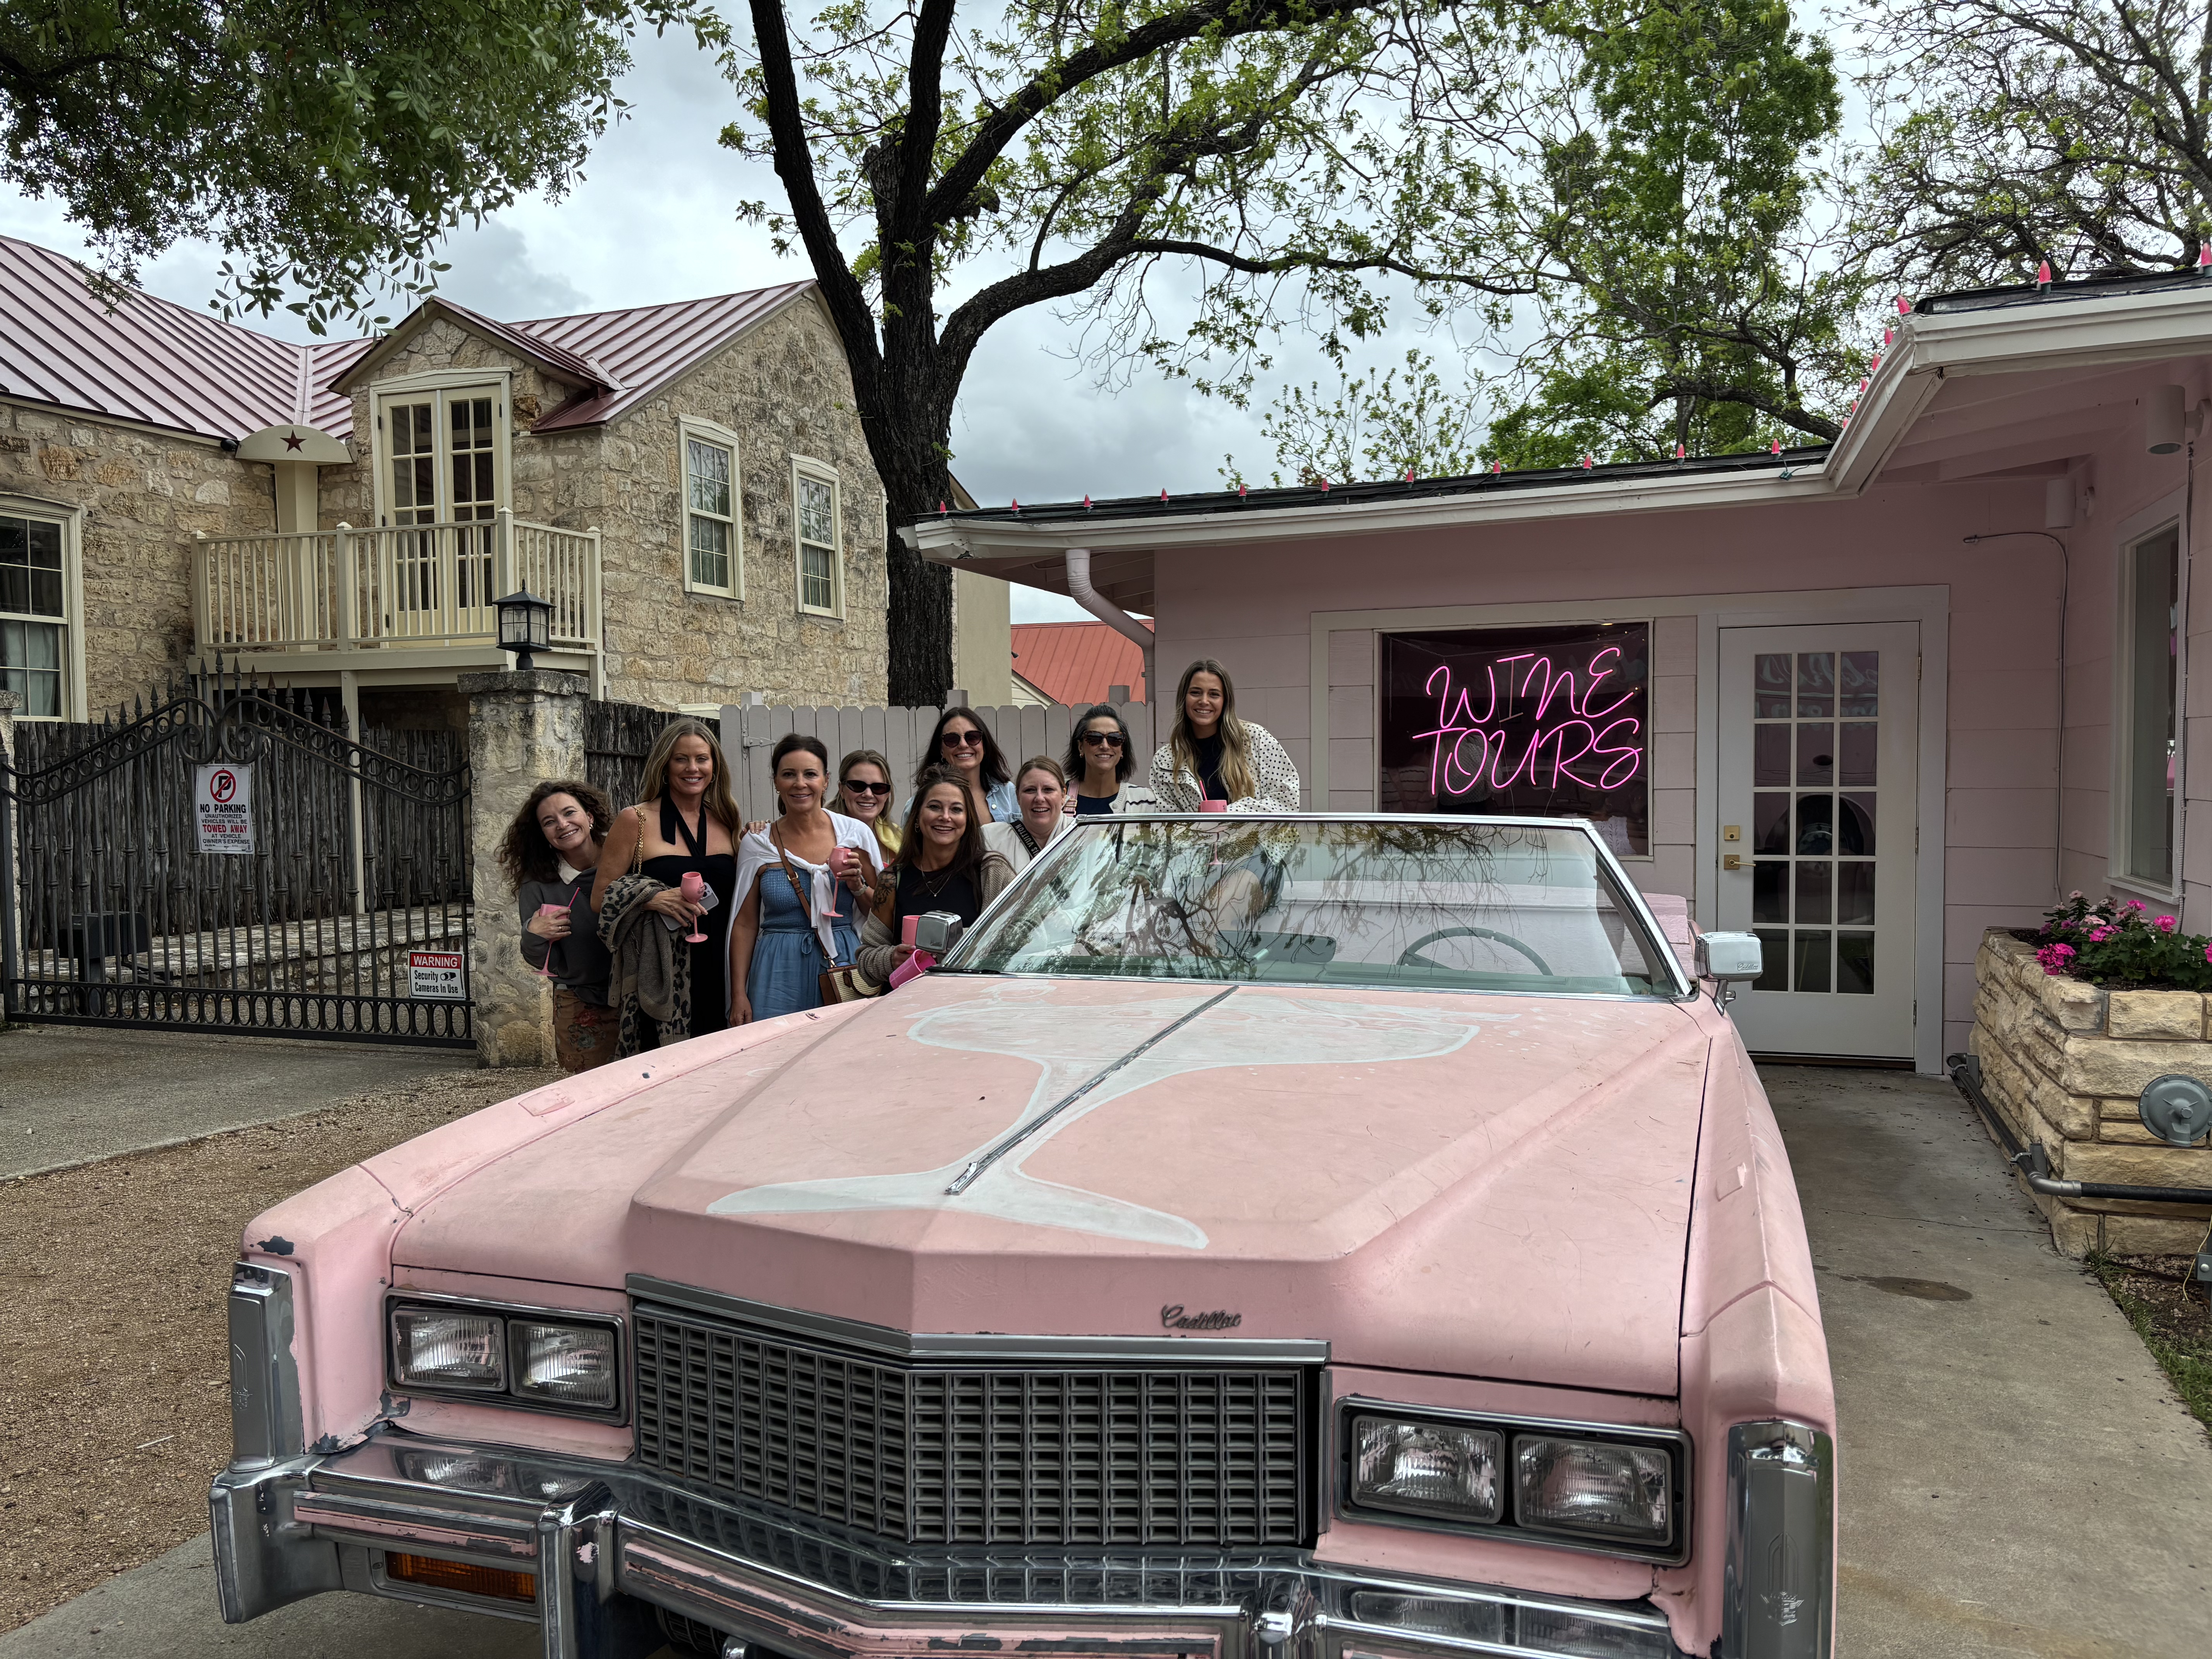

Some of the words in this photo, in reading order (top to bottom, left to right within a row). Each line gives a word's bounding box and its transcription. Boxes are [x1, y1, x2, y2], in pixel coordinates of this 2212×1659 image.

[1426, 647, 1634, 729] WINE
[1412, 718, 1643, 795] TOURS
[218, 776, 232, 798] P
[200, 804, 210, 813] NO
[214, 804, 246, 813] PARKING
[203, 824, 227, 833] TOWED
[230, 824, 247, 833] AWAY
[1015, 824, 1034, 848] VUITTON
[414, 955, 458, 967] WARNING
[414, 970, 438, 982] Security
[415, 982, 439, 993] Cameras
[440, 983, 446, 993] In
[447, 984, 459, 993] Use
[1161, 1304, 1242, 1330] Cadillac
